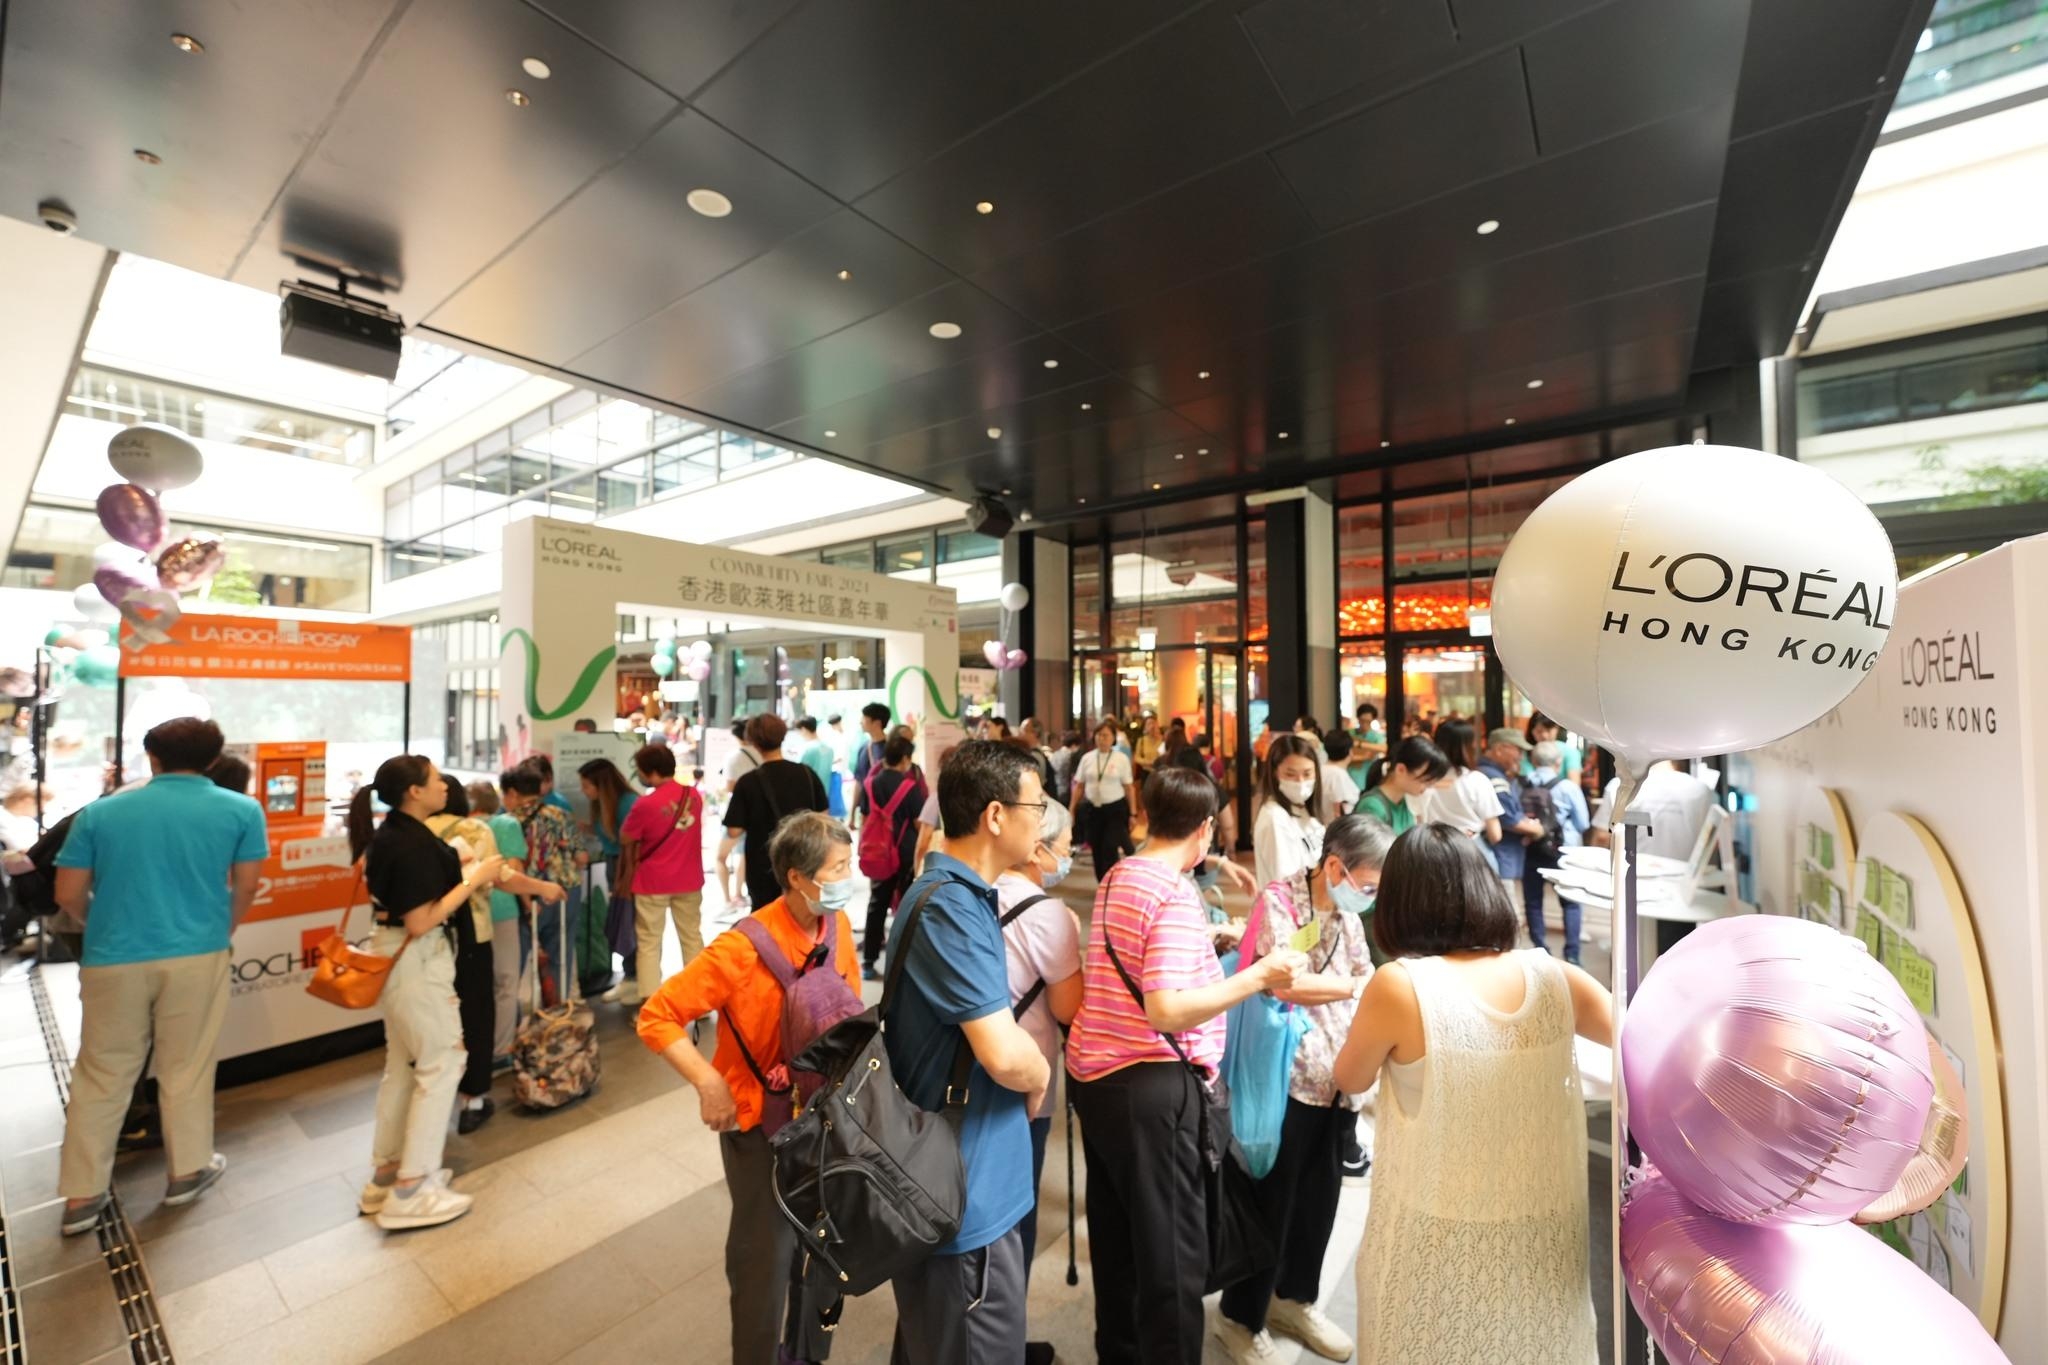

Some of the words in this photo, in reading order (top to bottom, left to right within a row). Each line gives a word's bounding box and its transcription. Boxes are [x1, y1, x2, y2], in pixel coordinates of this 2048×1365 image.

[541, 555, 581, 568] HONG
[587, 561, 623, 573] KONG
[806, 571, 834, 589] FAIR
[838, 576, 870, 594] 2024
[678, 575, 889, 622] 香港歐萊雅社區嘉年華
[1611, 551, 1891, 630] L'ORÉAL
[1602, 611, 1750, 651] HONG
[1777, 636, 1879, 672] KONG
[1900, 629, 1995, 688] L'ORÉAL
[1903, 706, 1938, 729] HONG
[1946, 706, 1997, 735] KONG
